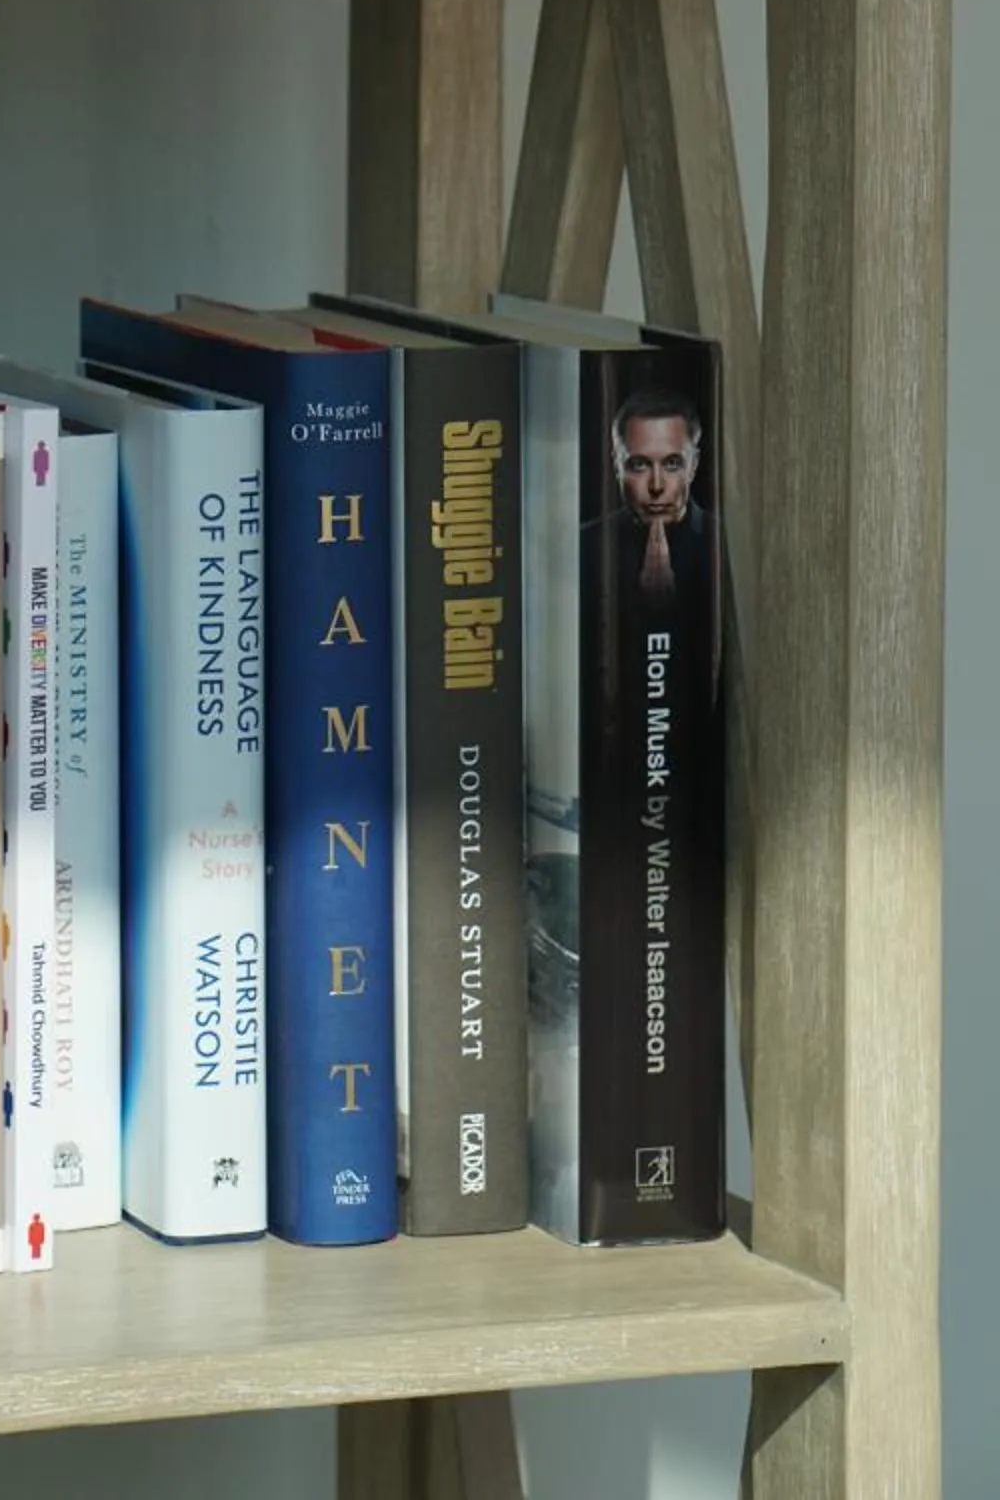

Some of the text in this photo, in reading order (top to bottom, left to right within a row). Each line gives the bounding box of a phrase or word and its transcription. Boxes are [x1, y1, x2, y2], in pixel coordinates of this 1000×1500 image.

[291, 422, 383, 443] O'Farrell
[306, 402, 370, 420] Maggie
[69, 534, 88, 744] The MINISTRY
[197, 493, 225, 738] OF KINDNESS
[237, 470, 260, 755] THE LANGUAGE
[431, 419, 504, 690] Shuggie Bain
[30, 567, 48, 811] MAKE DIVERSITY MATTER TO YOU
[202, 861, 254, 881] Story
[317, 493, 373, 1112] HAMNET
[459, 744, 484, 1061] DOUGLAS STUART
[640, 632, 671, 1074] Elon Musk by Walter Isaacson
[29, 941, 46, 1109] Tahmid Chowdhury
[55, 860, 74, 1092] ARUNDHATI ROY
[194, 933, 223, 1088] WATSON
[235, 931, 258, 1086] CHRISTIE
[460, 1113, 485, 1195] PICADOR
